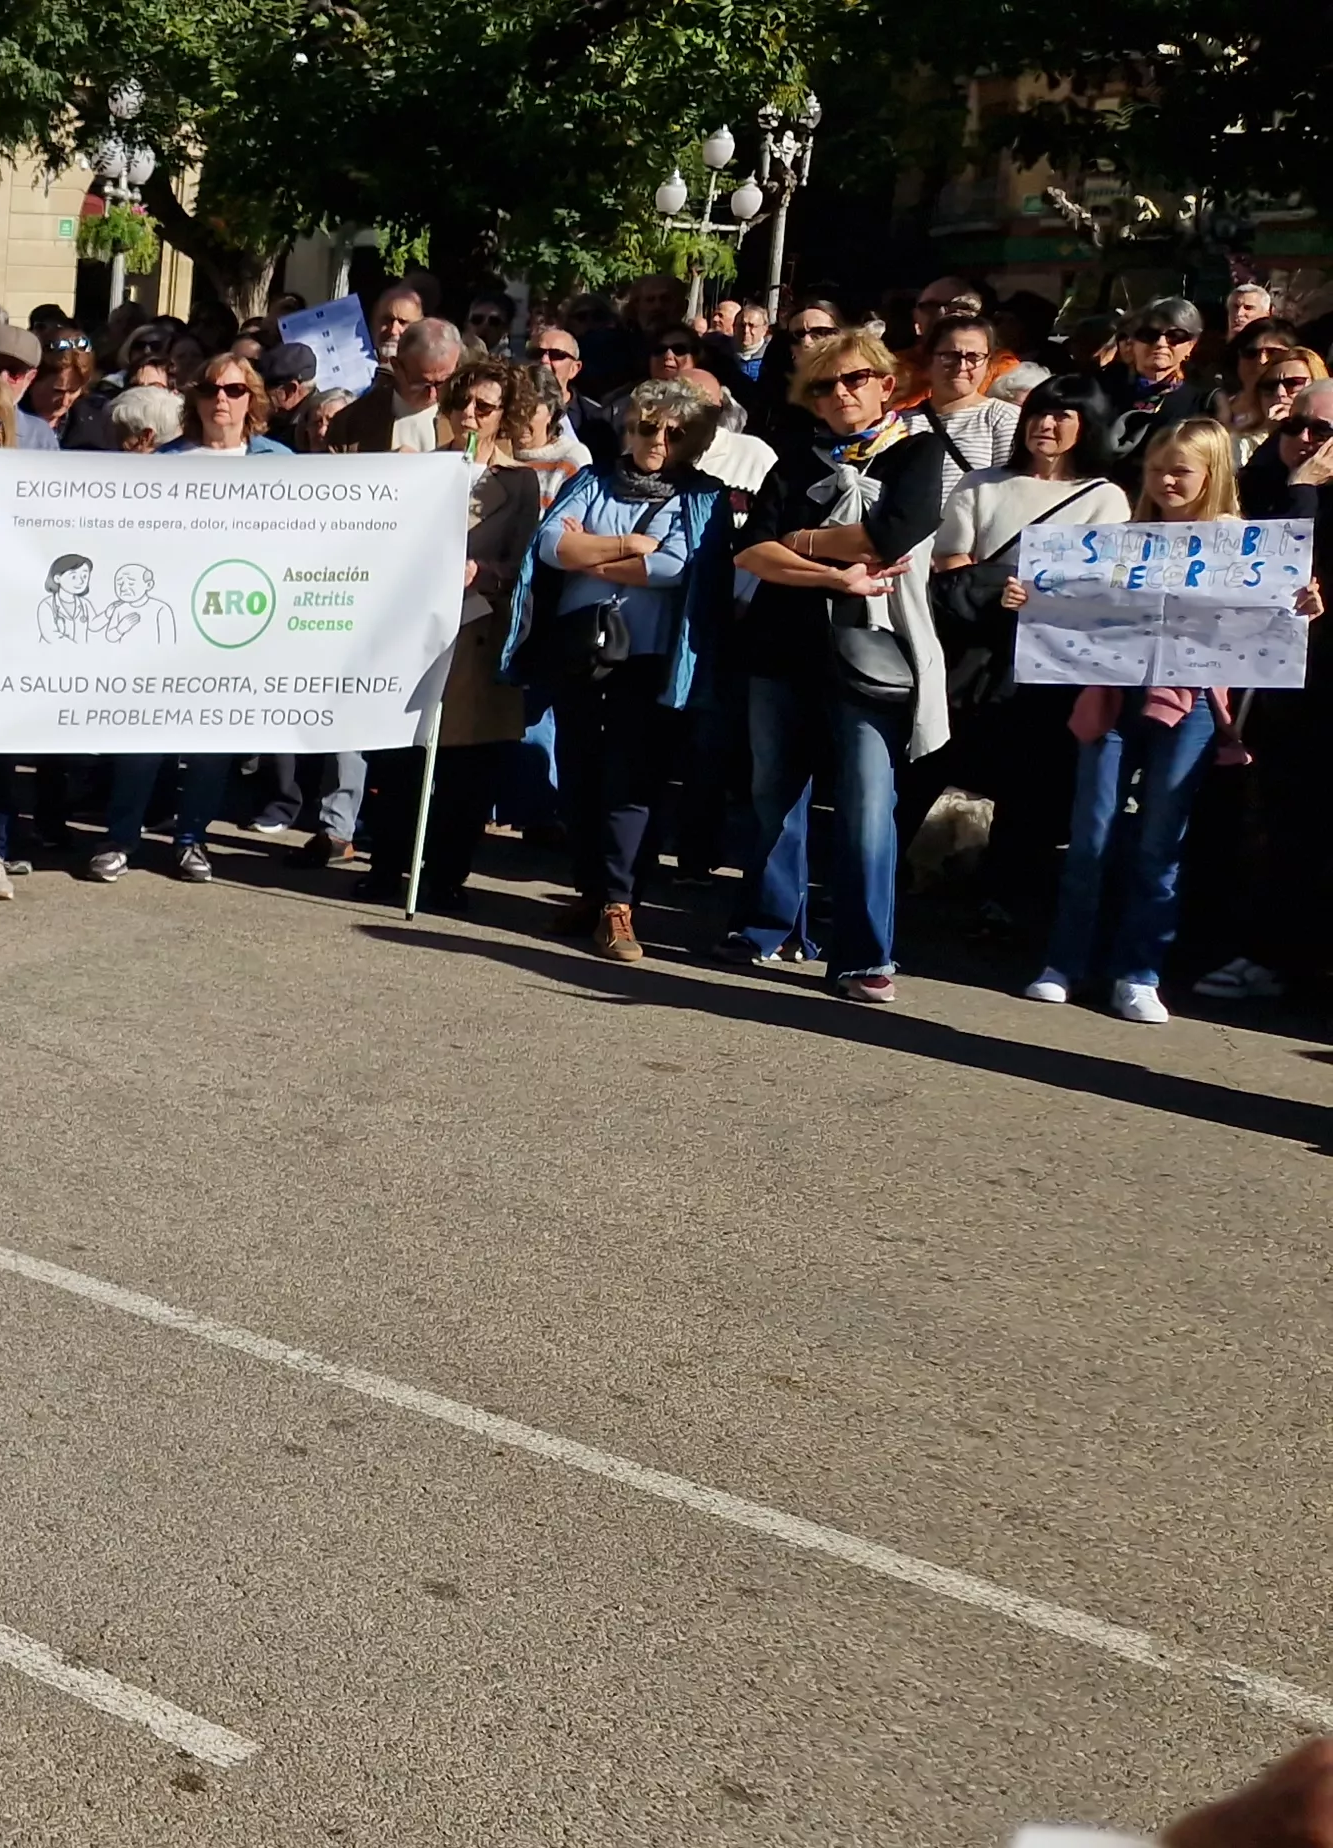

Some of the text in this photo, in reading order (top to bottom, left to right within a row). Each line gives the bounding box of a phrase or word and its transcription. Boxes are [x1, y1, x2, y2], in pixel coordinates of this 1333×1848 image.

[16, 479, 399, 501] EXIGIMOS LOS 4 REUMATÓLOGOS YA:
[13, 515, 398, 533] Tenemos: listas de espera, dolor, incapacidad y abandono
[1082, 530, 1202, 564] SANIDAD
[283, 565, 370, 582] Asociación
[1109, 560, 1265, 590] RECORTES
[202, 590, 268, 616] ARO
[293, 590, 355, 607] aRtritis
[287, 615, 354, 631] Oscense
[19, 675, 89, 694] SALUD
[95, 676, 127, 694] NO
[132, 676, 158, 694] SE
[162, 676, 258, 696] RECORTA,
[263, 676, 290, 694] SE
[293, 676, 403, 694] DEFIENDE,
[57, 709, 334, 727] EL PROBLEMA ES DE TODOS
